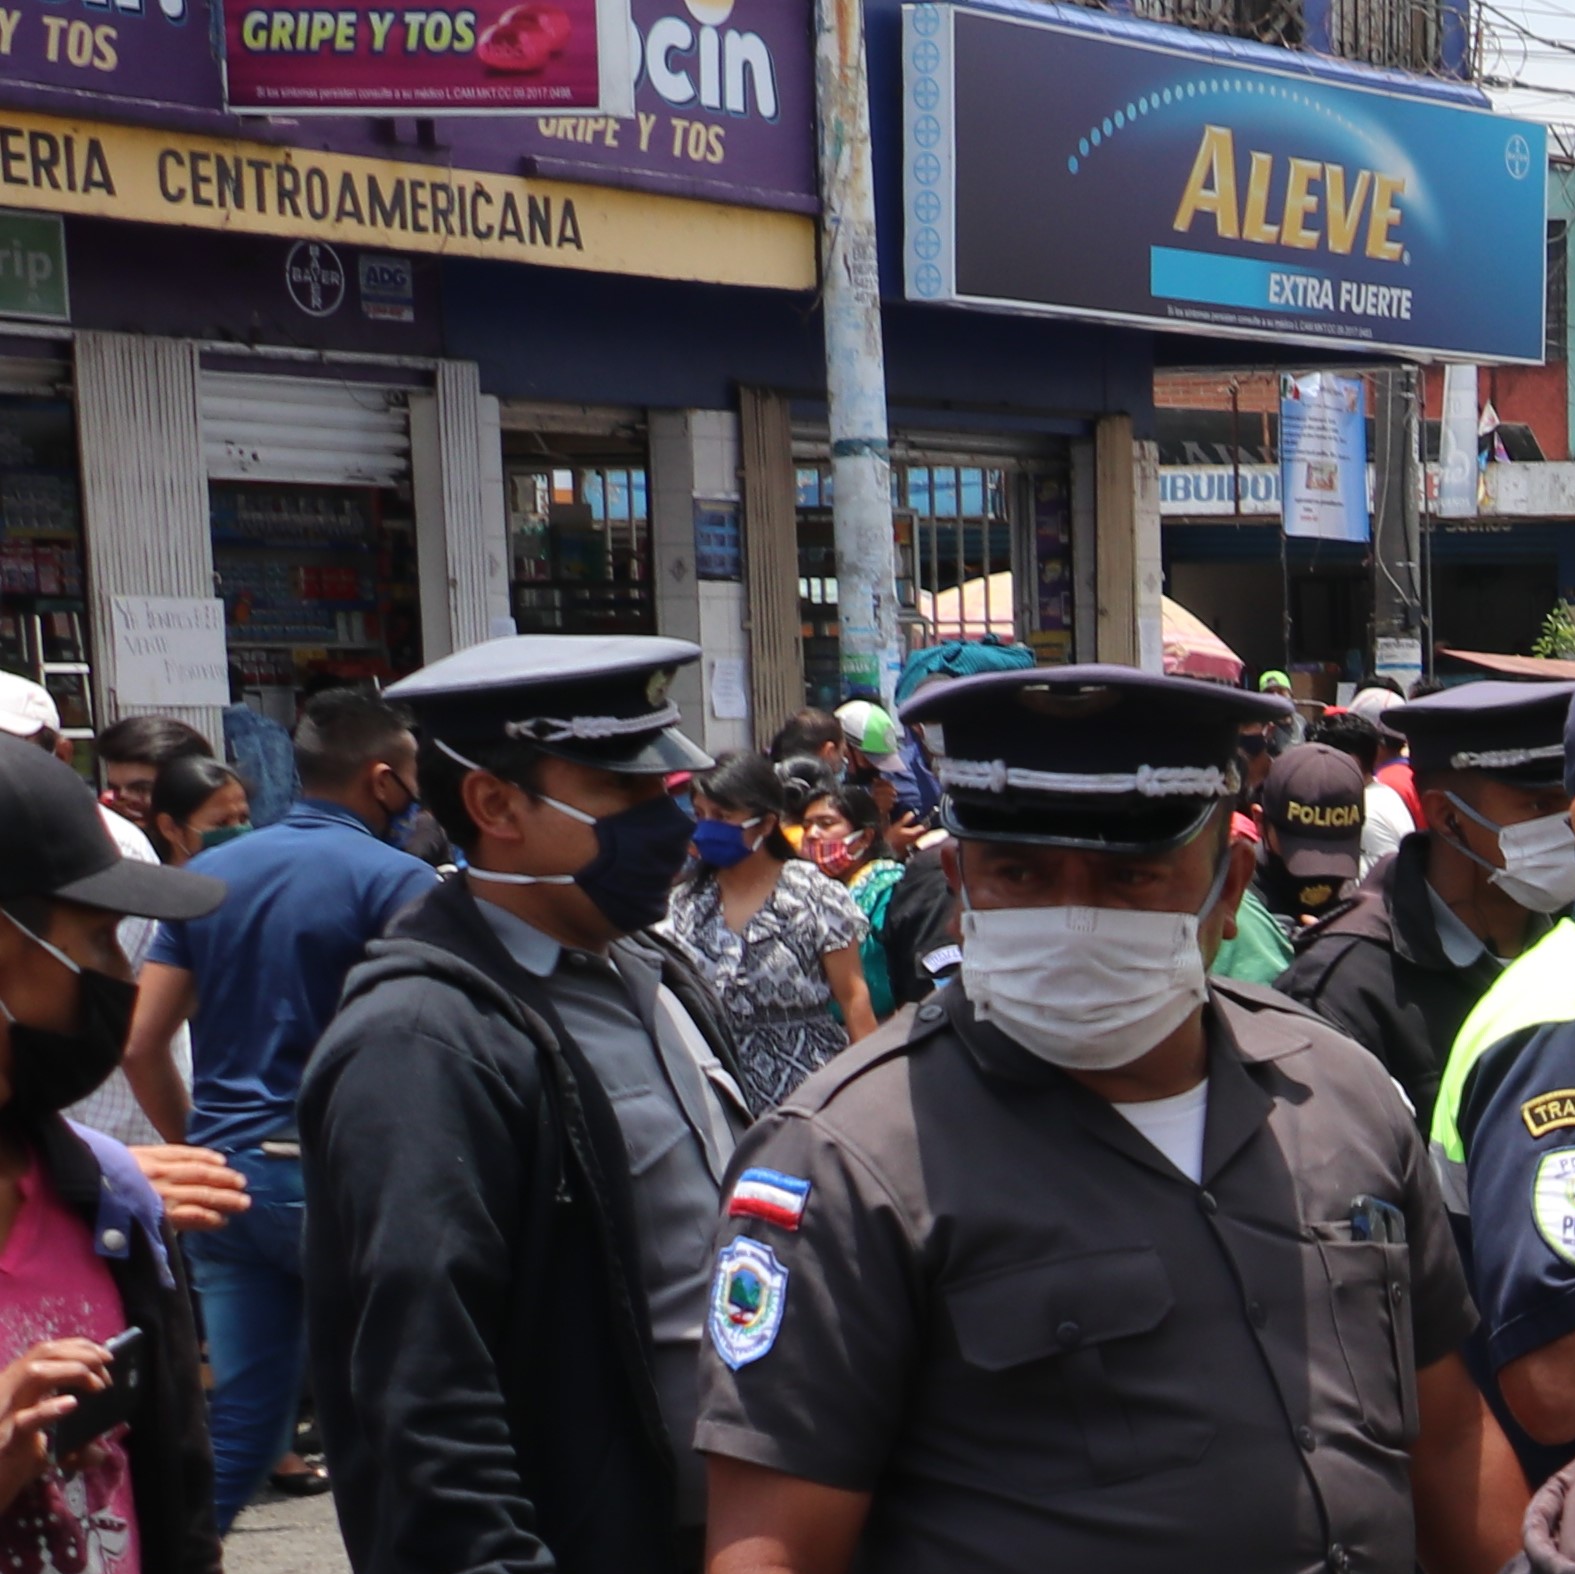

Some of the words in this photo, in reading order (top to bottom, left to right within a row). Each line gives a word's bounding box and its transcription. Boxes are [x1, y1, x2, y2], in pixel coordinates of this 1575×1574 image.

[42, 14, 118, 72] TOS
[243, 11, 357, 50] GRIPE
[368, 11, 394, 50] Y
[404, 11, 476, 50] TOS
[631, 0, 777, 120] cin
[638, 113, 657, 152] Y
[671, 118, 725, 164] TOS
[158, 148, 584, 252] CENTROAMERICANA
[1173, 124, 1406, 262] ALEVE
[1269, 271, 1335, 312] EXTRA
[1339, 279, 1413, 320] FUERTE
[1287, 800, 1361, 827] POLICIA
